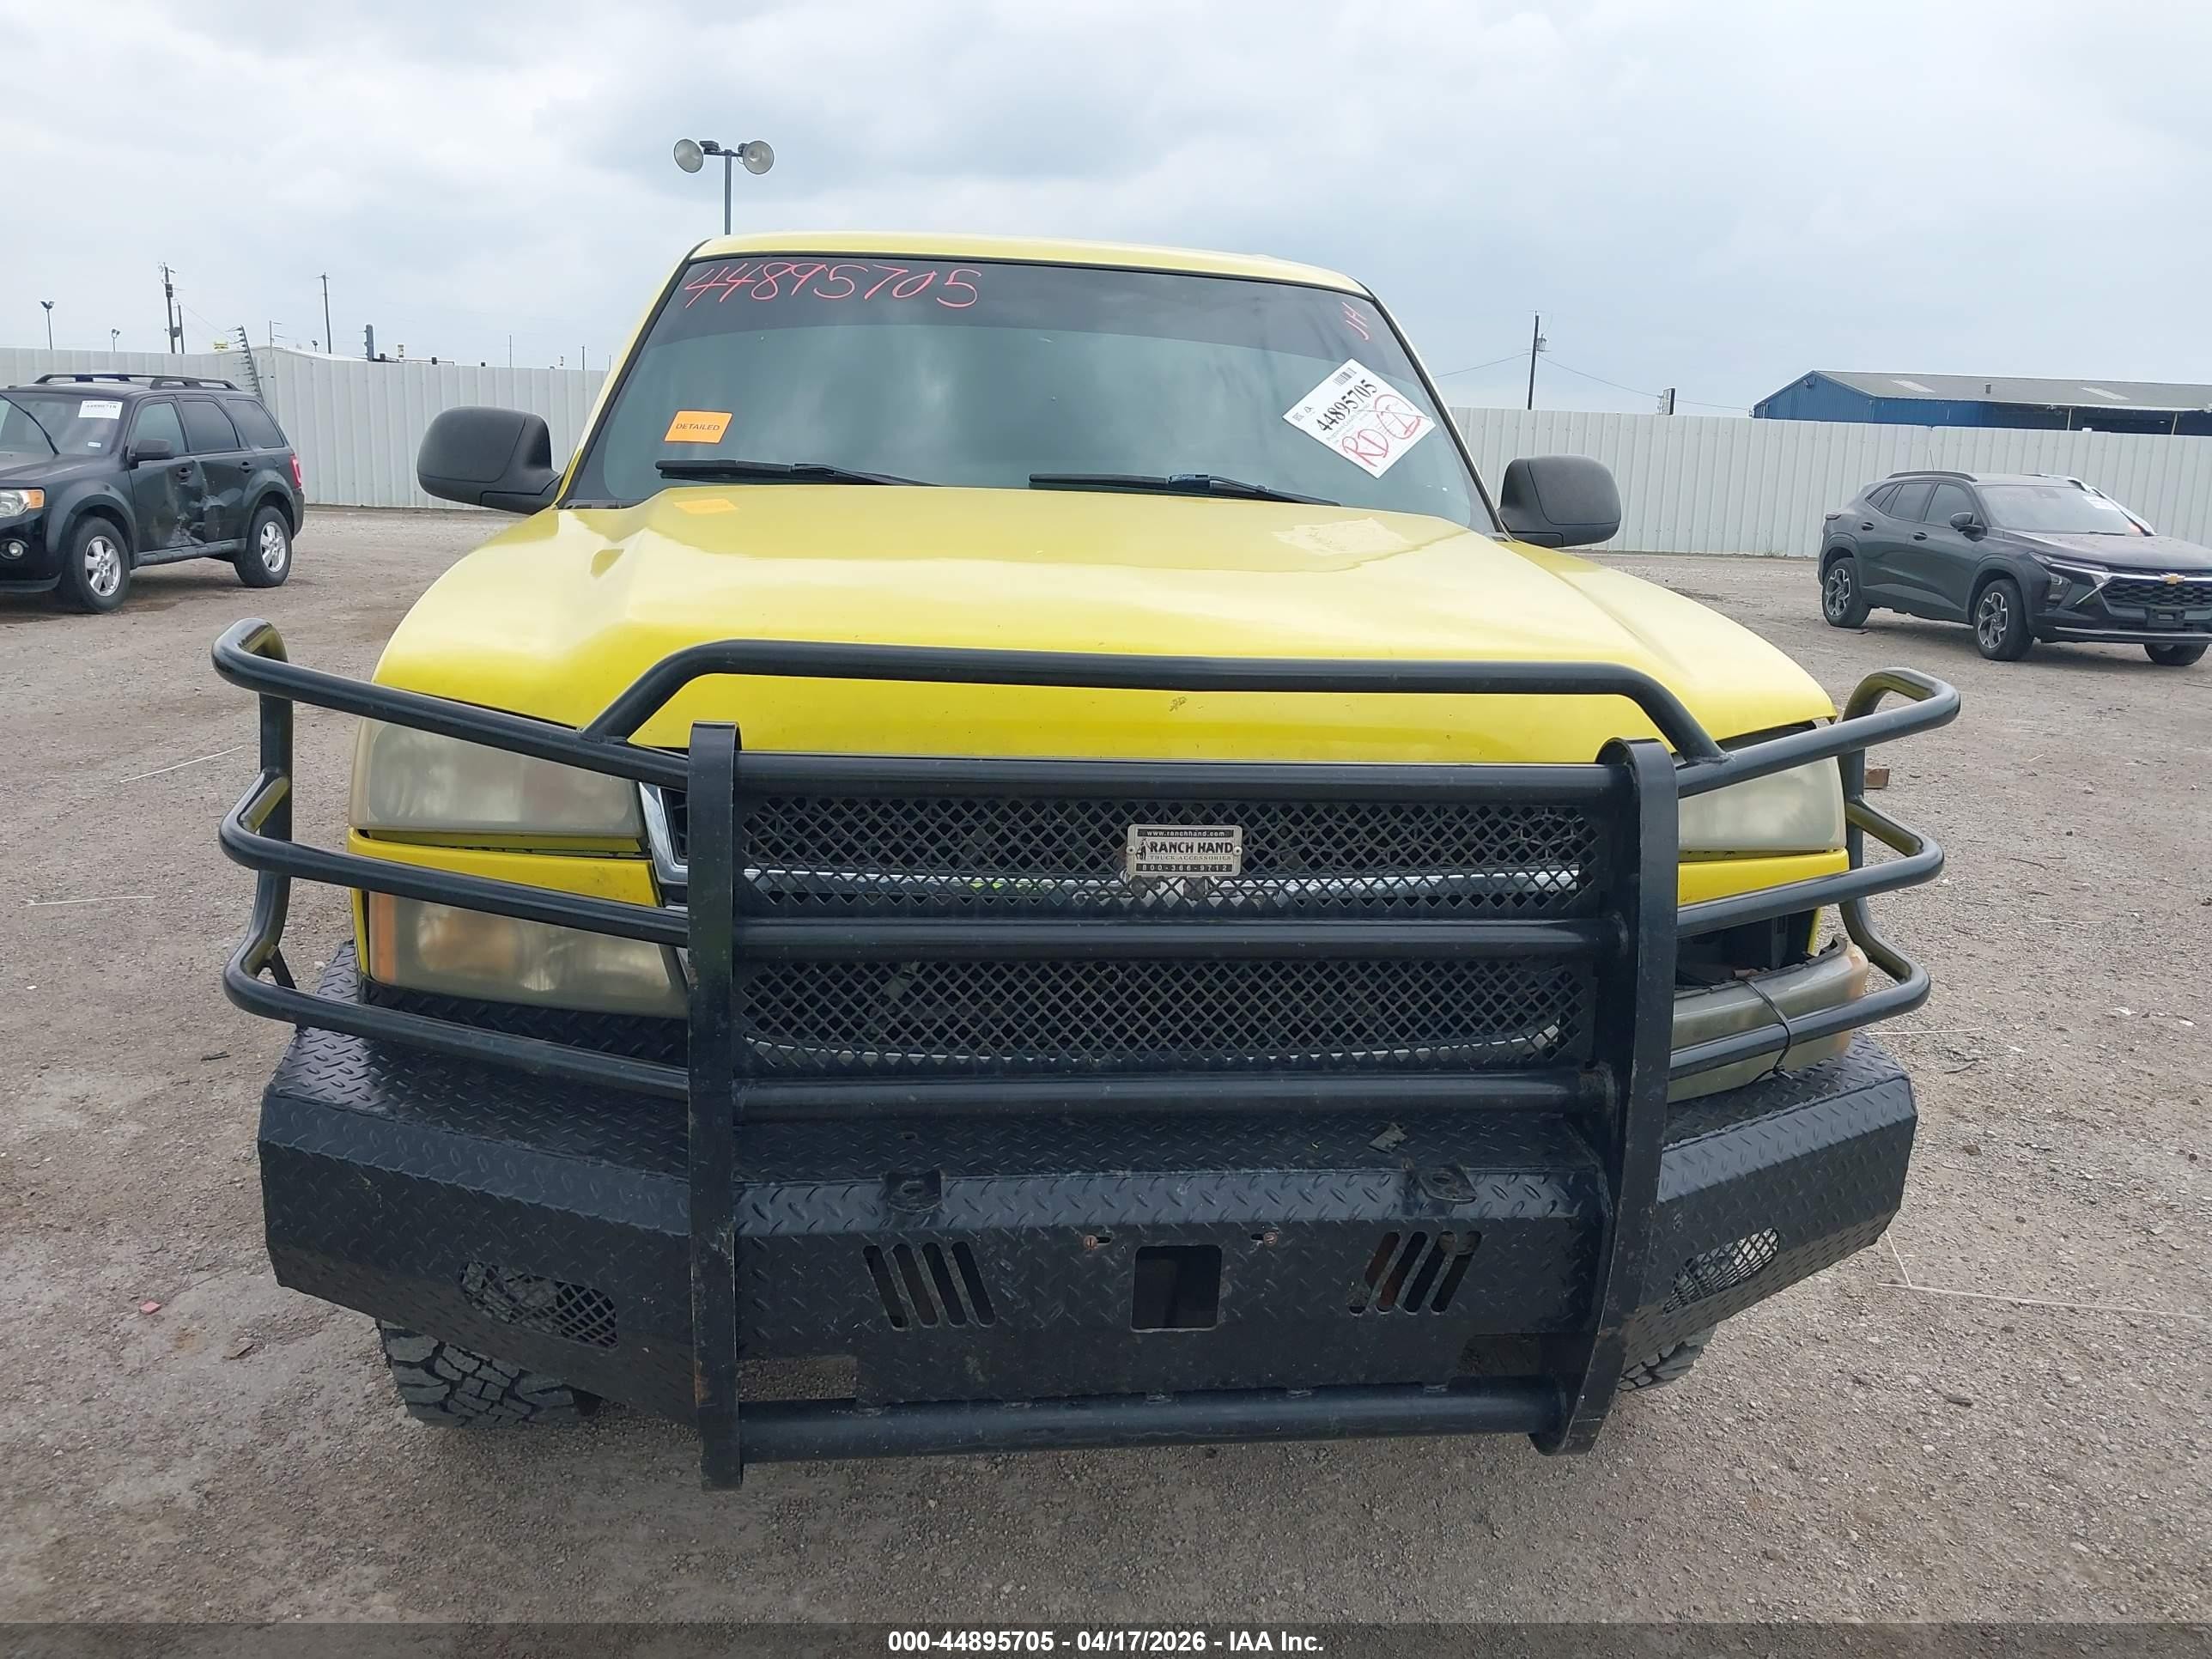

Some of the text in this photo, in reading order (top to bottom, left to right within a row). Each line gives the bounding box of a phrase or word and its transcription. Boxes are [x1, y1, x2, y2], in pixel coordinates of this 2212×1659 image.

[684, 262, 981, 308] 44895705
[1316, 379, 1377, 431] 44895705
[1151, 842, 1233, 854] RANCH HAND
